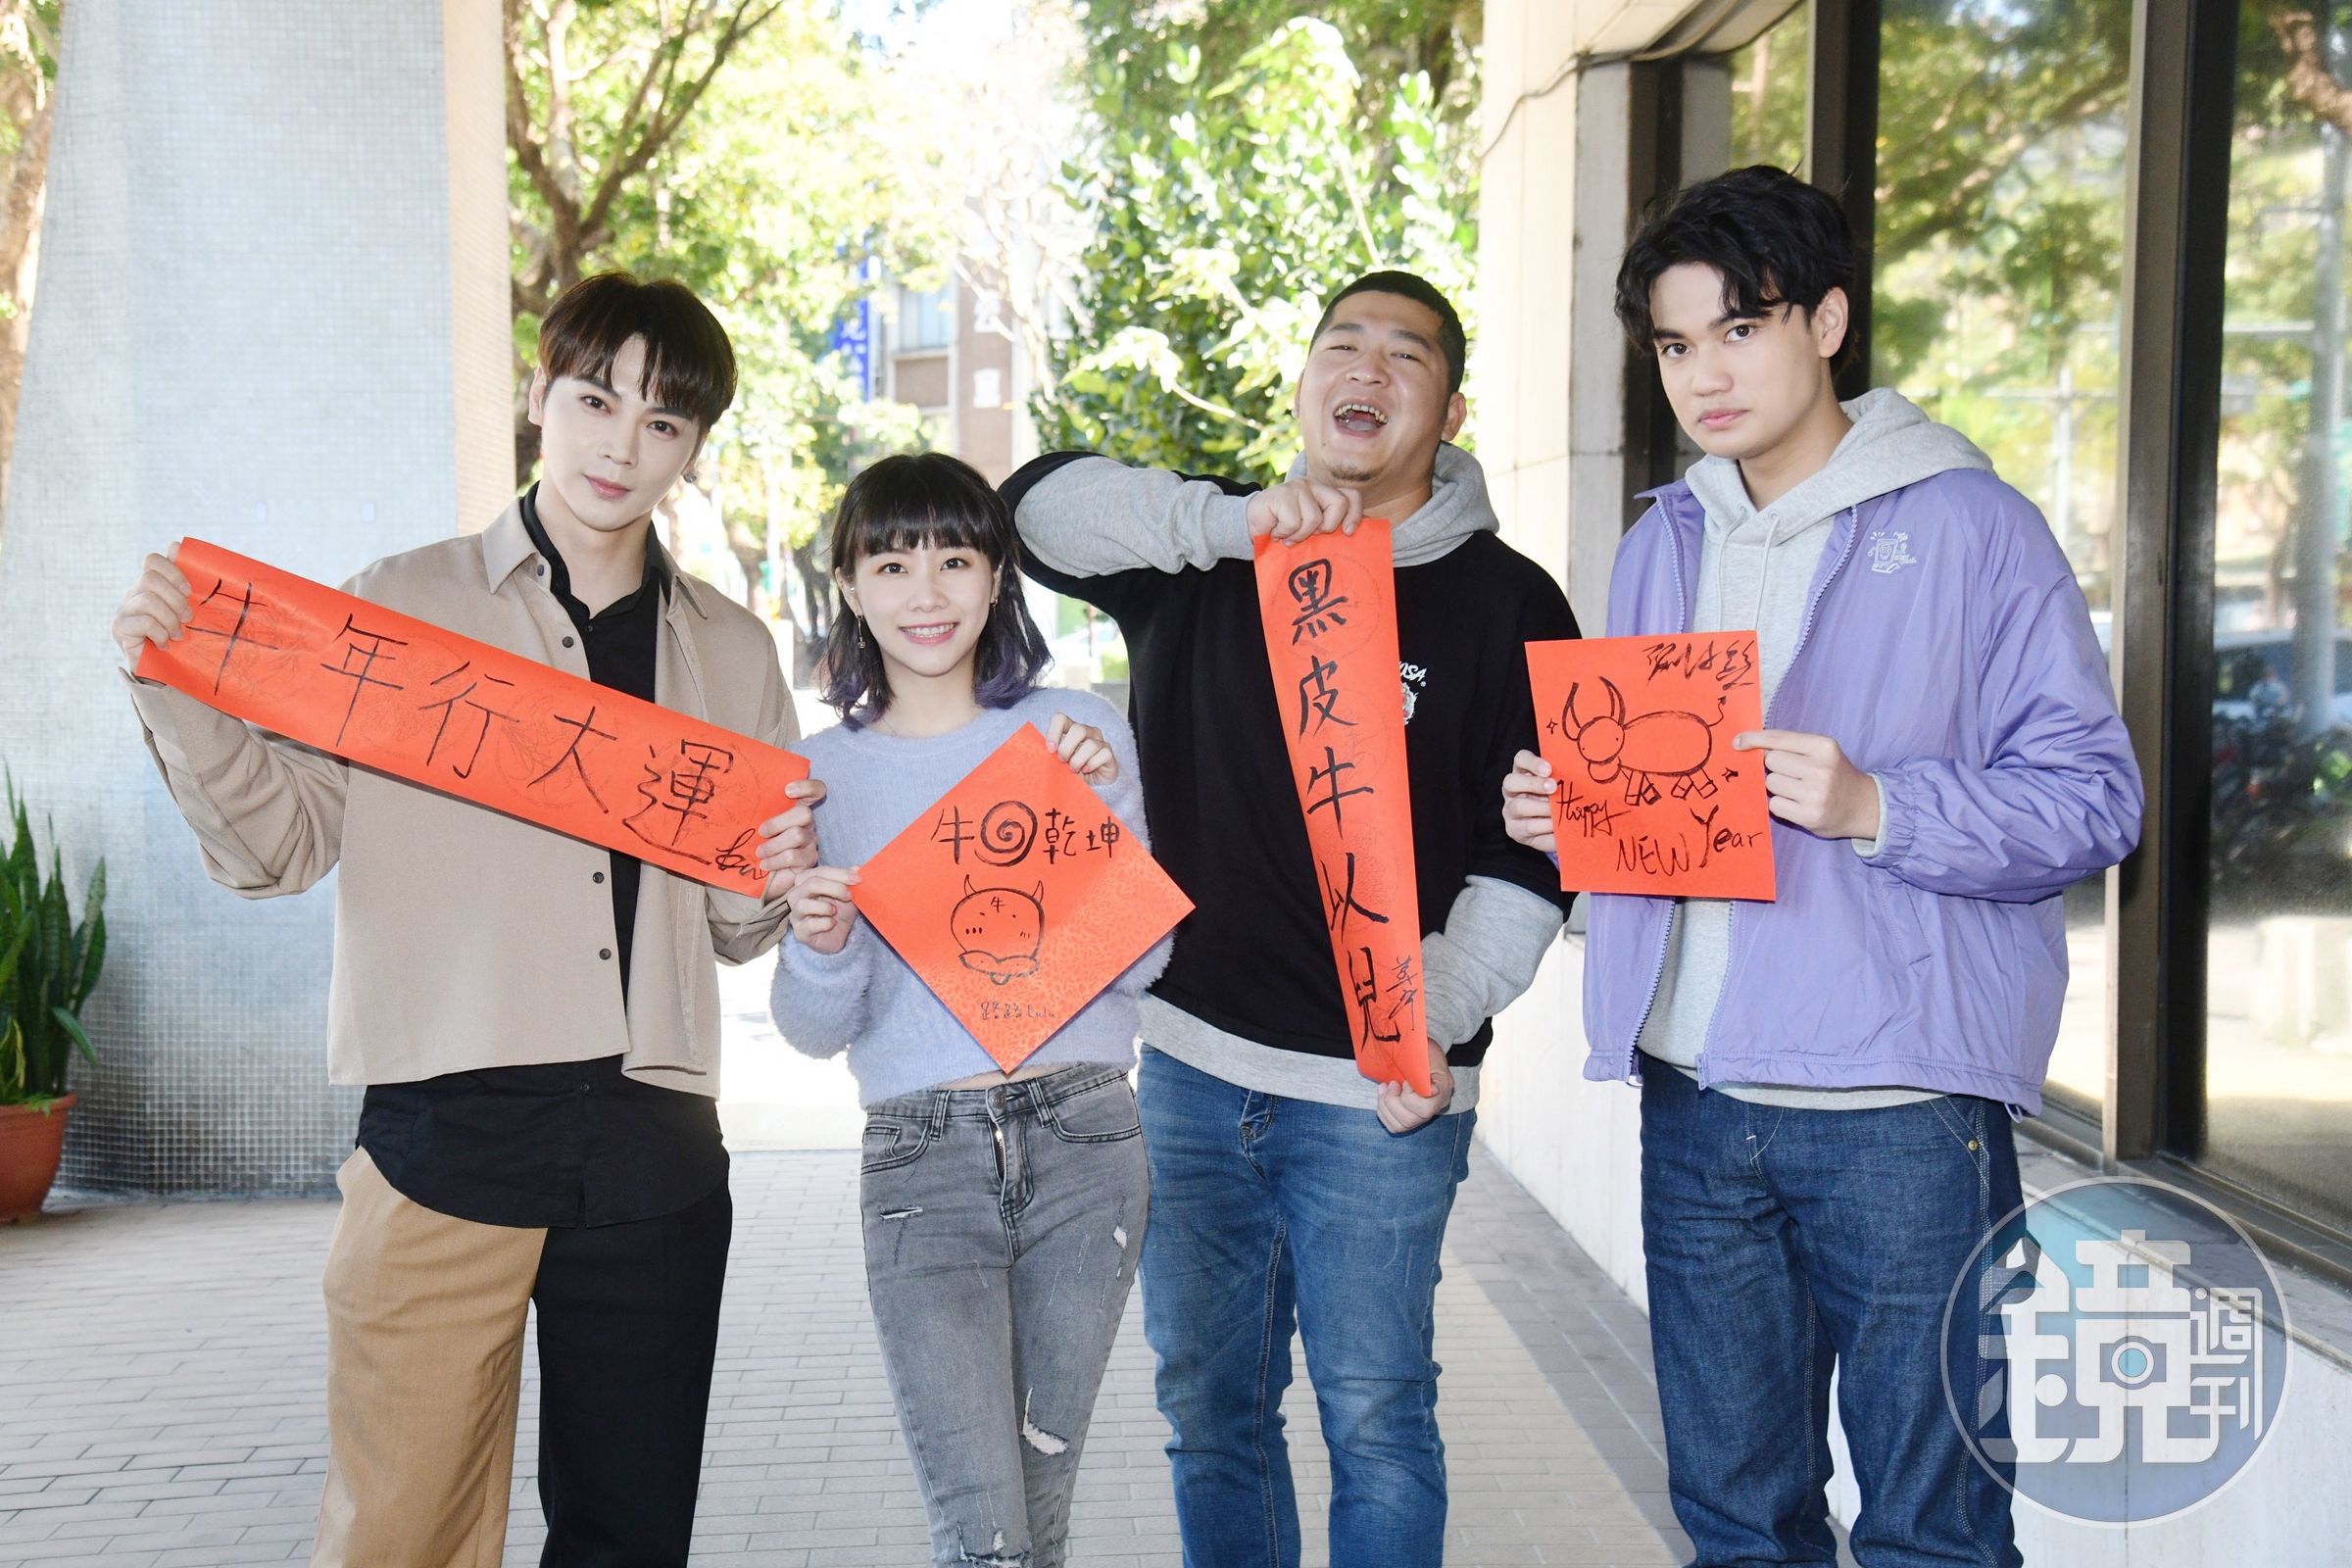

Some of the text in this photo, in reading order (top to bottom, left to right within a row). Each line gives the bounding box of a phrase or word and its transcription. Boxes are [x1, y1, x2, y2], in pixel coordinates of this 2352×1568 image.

[185, 576, 734, 866] 牛年行大運
[1556, 779, 1632, 839] Happy
[1616, 804, 1763, 877] NEW Year
[990, 896, 1005, 913] 牛
